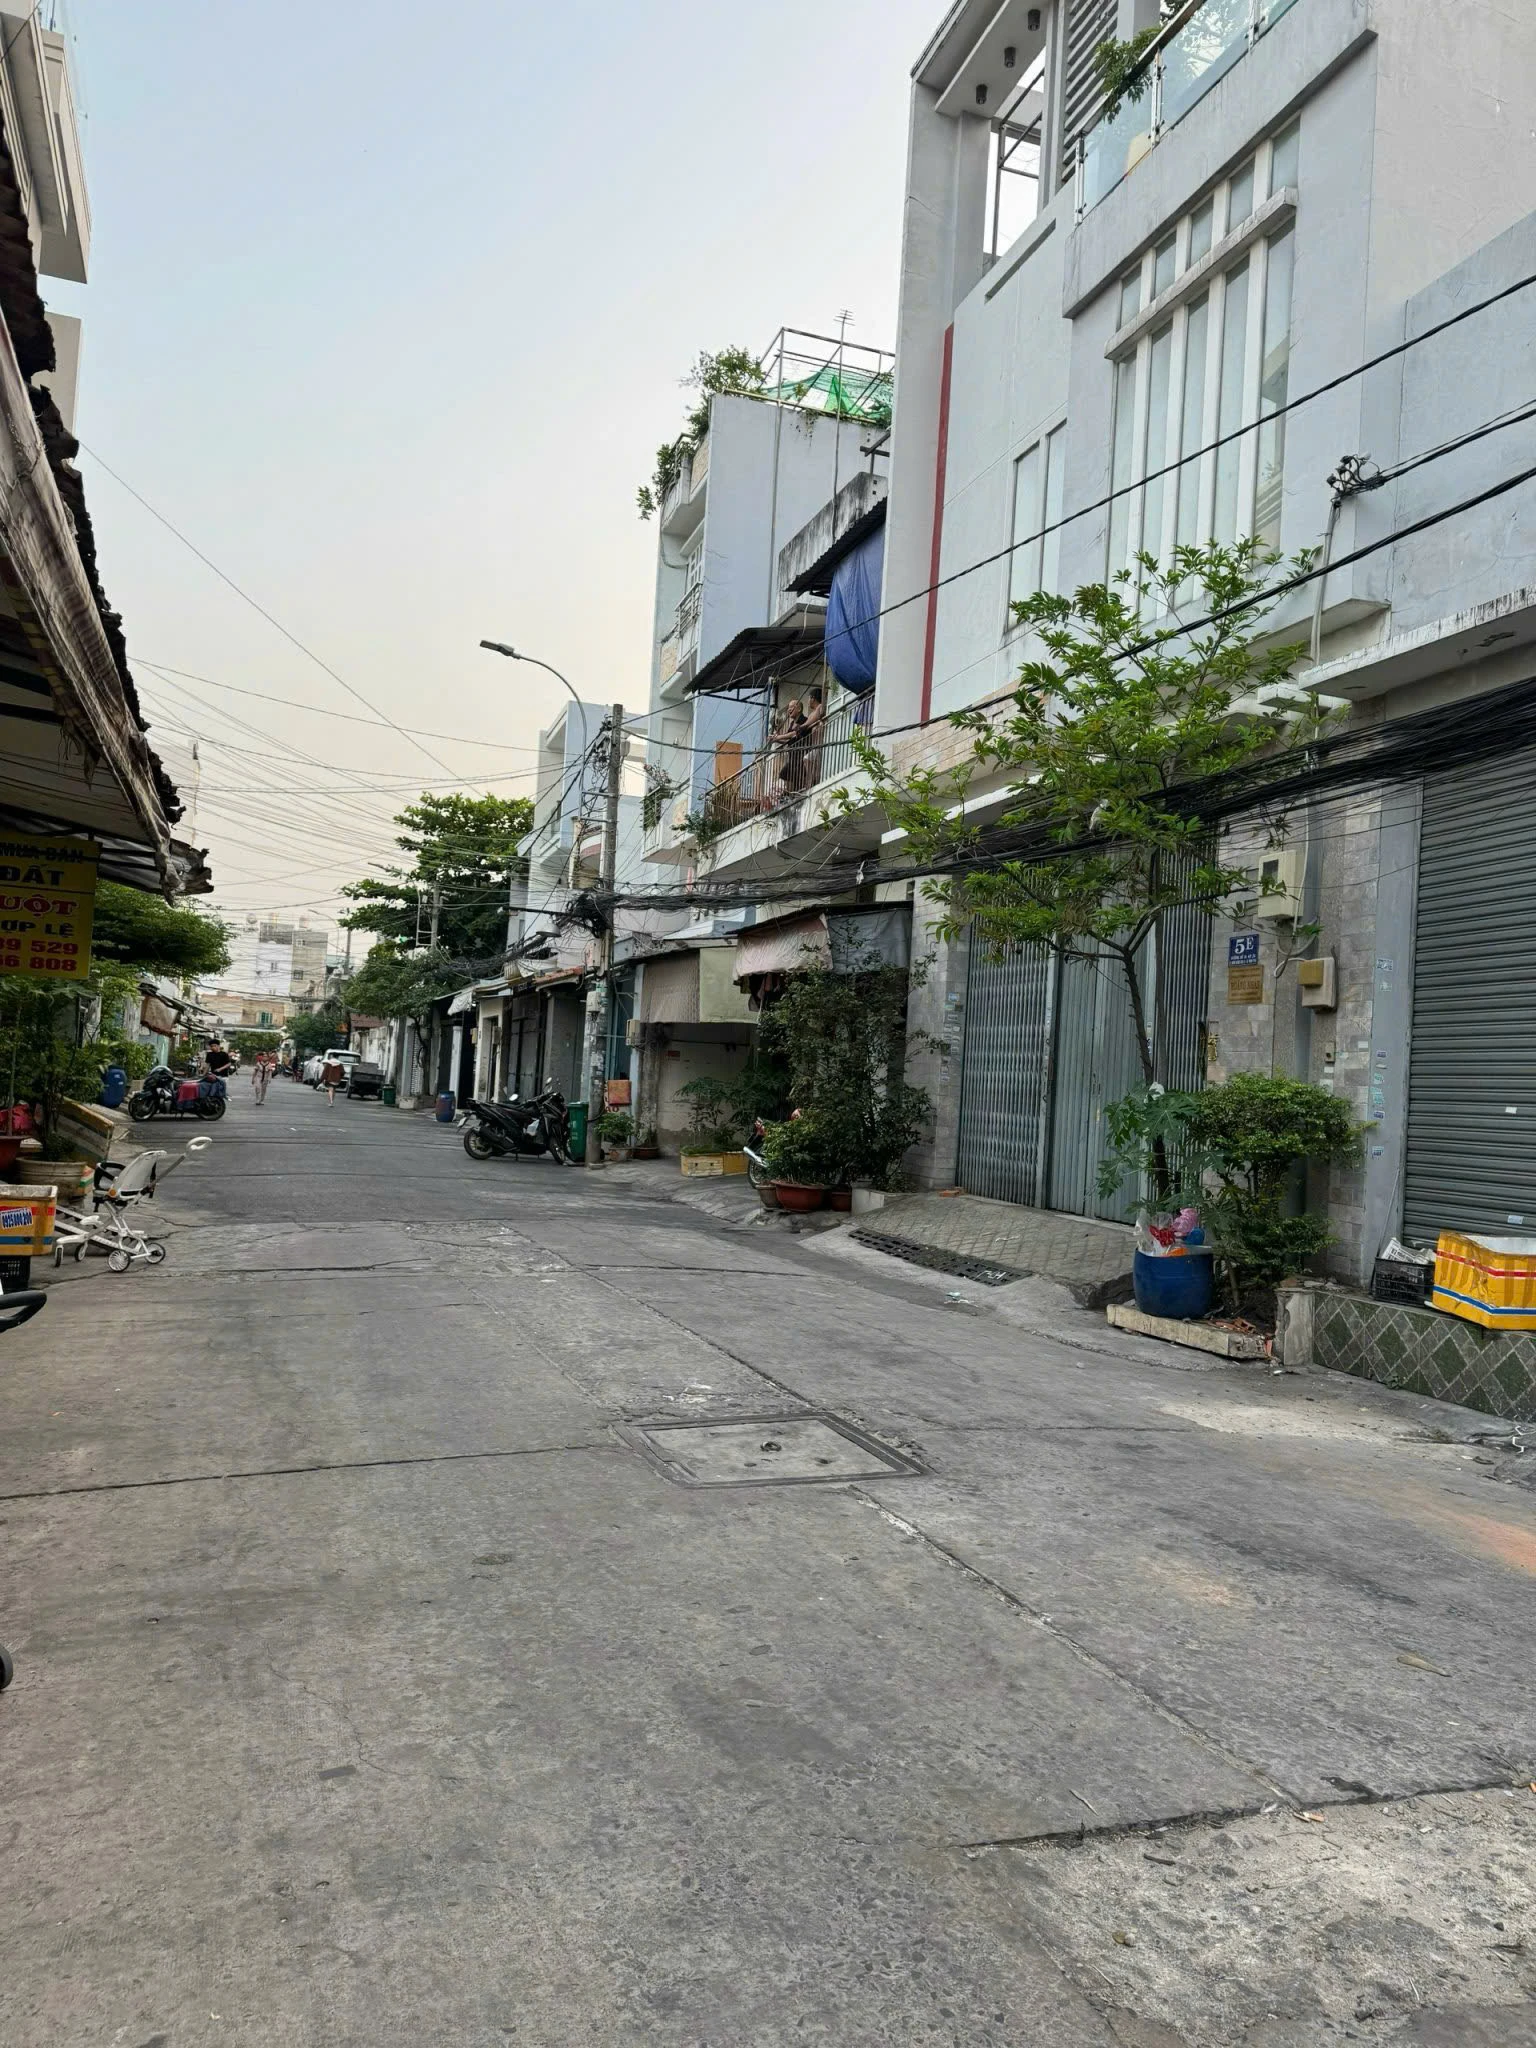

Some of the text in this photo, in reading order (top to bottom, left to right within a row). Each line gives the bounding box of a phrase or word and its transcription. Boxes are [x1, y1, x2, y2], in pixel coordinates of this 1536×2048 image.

[31, 940, 78, 955] 529
[1234, 937, 1254, 954] 5E
[29, 956, 78, 972] 808
